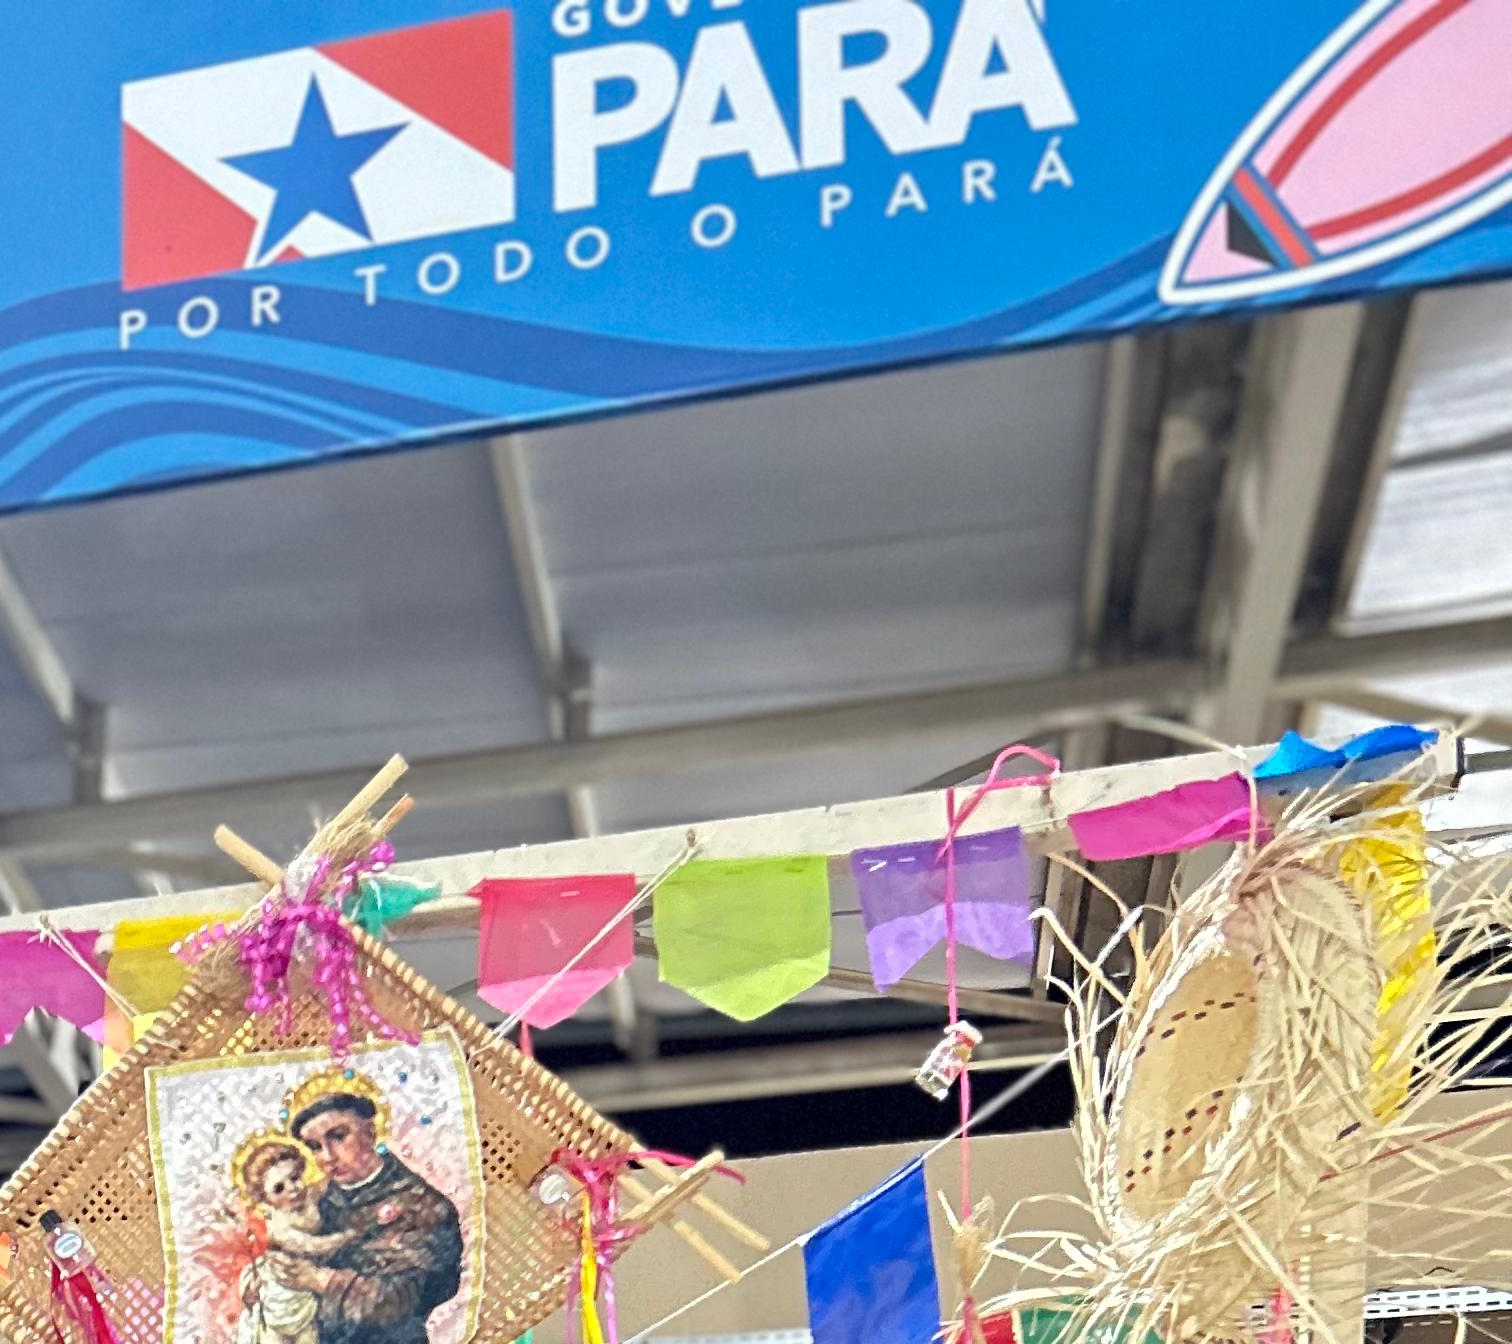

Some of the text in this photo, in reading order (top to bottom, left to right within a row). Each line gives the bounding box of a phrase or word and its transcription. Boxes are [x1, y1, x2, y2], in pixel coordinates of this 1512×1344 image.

[119, 137, 1074, 351] POR TODO O PARÁ
